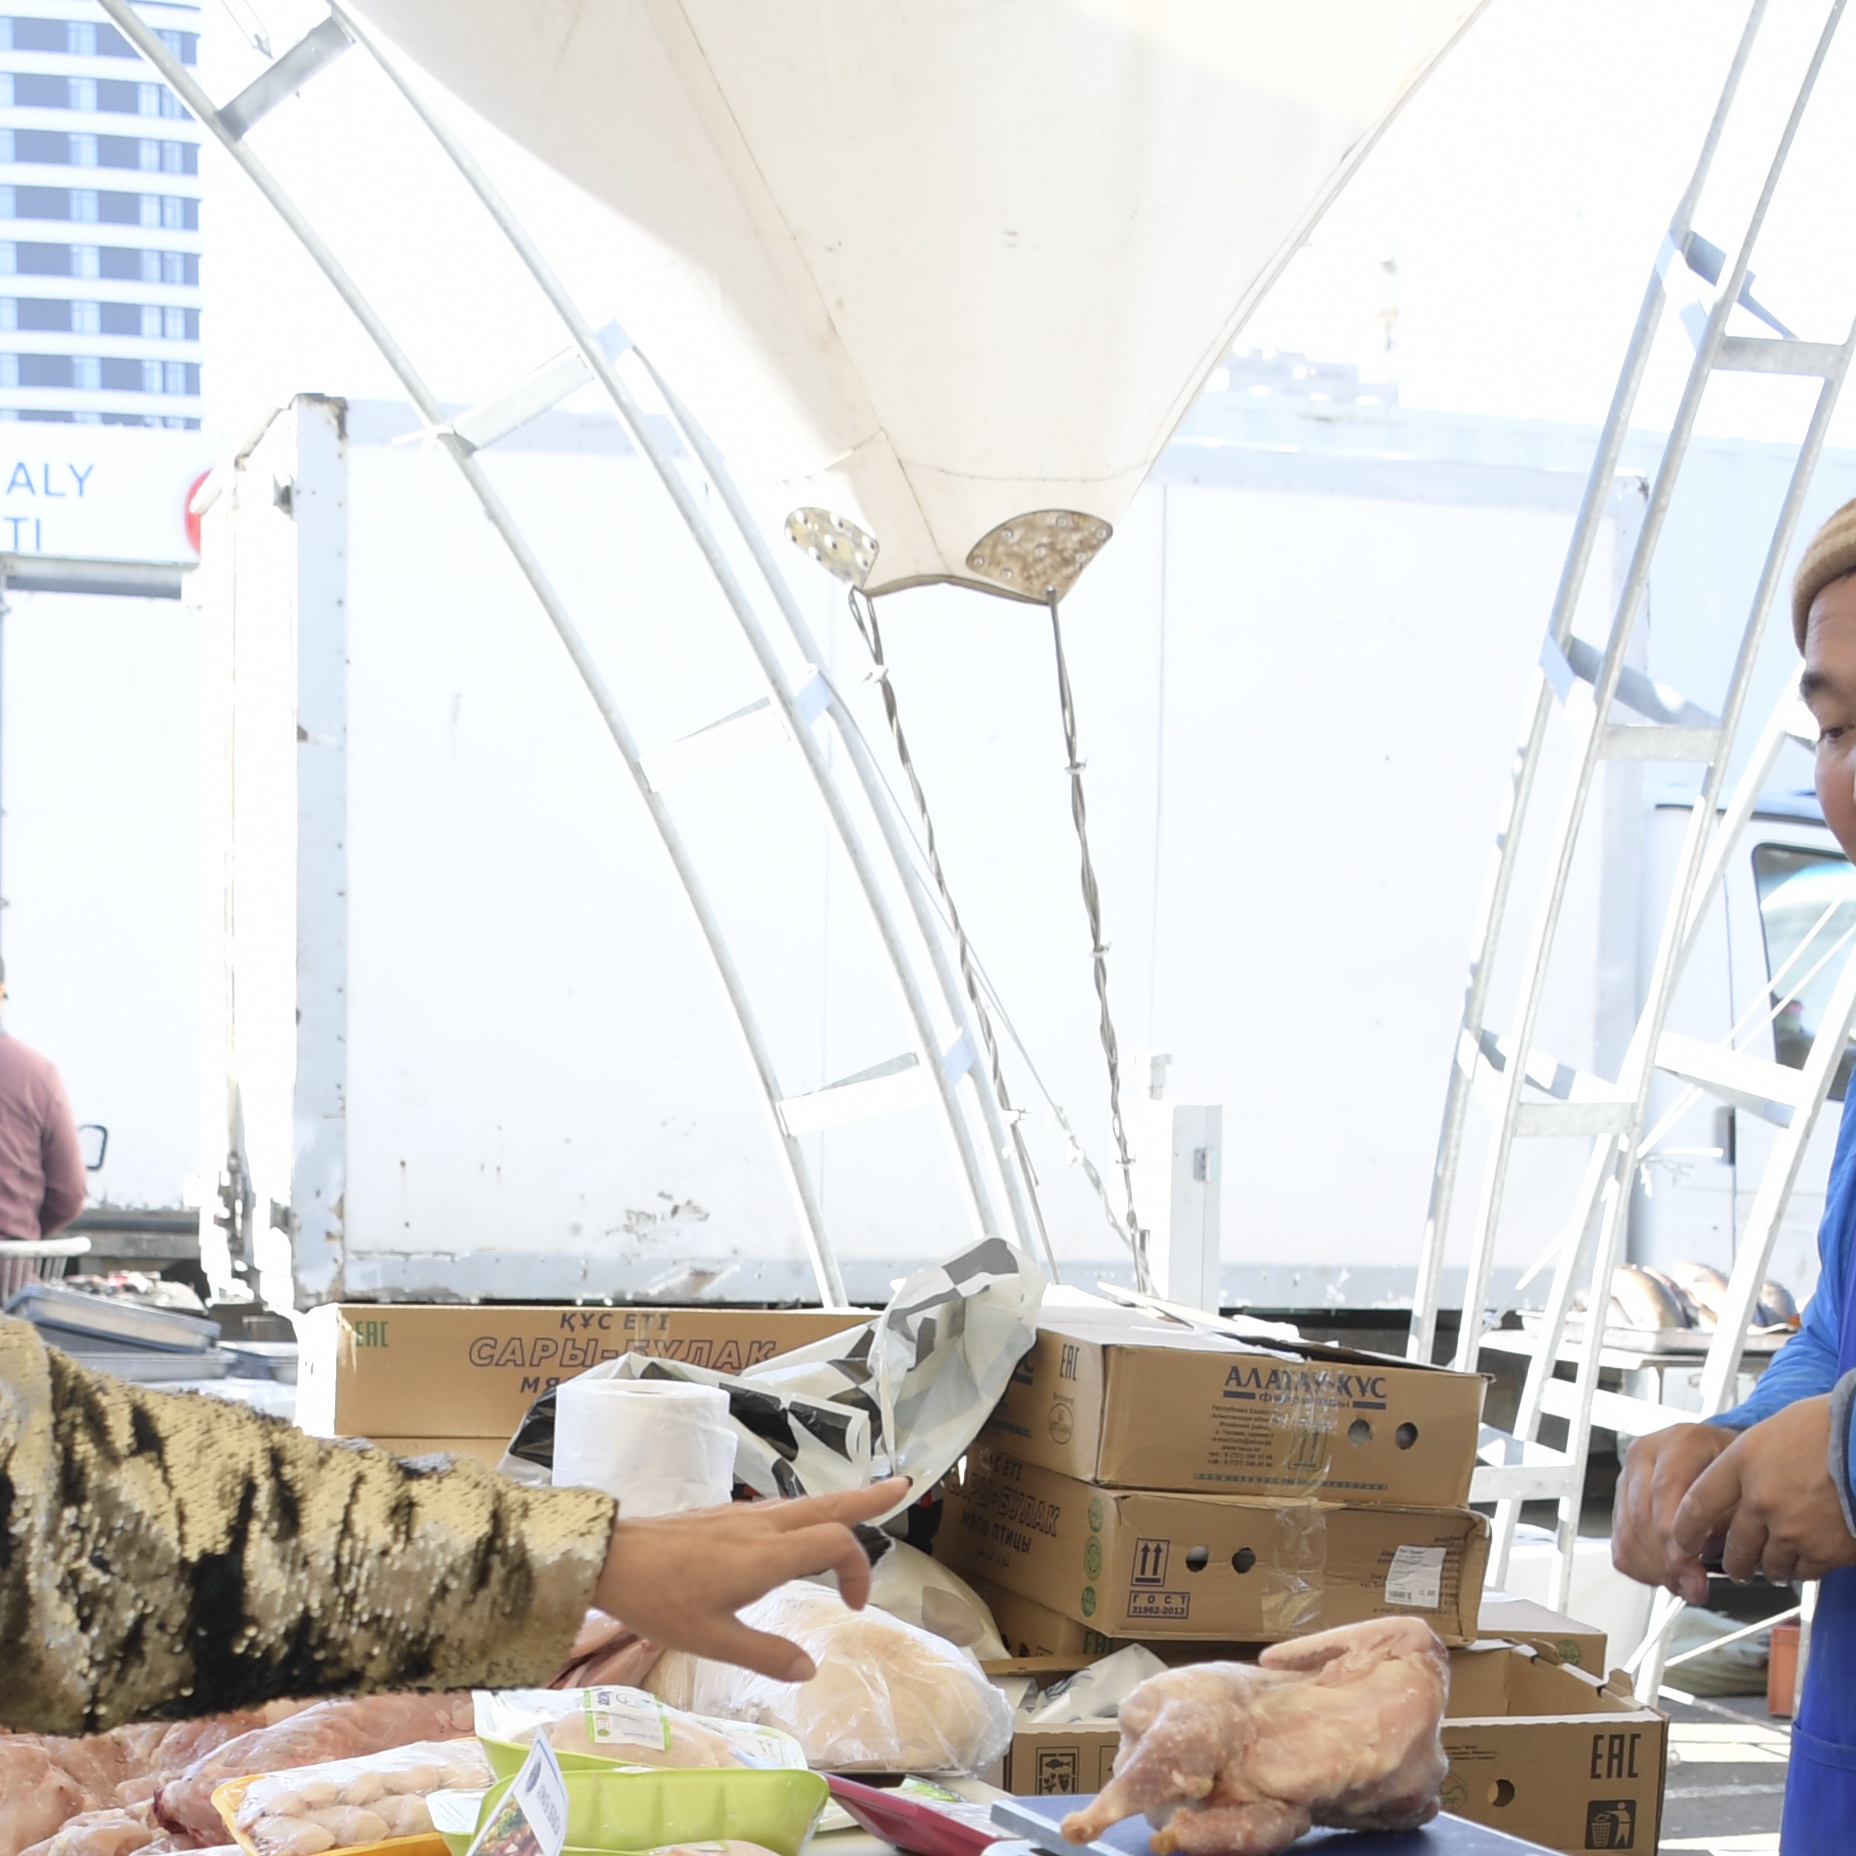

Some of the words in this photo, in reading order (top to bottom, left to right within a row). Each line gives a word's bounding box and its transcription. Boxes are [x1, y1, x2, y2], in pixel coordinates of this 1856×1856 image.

[6, 461, 94, 498] ALY
[520, 1375, 561, 1394] МЯ
[991, 1520, 1033, 1555] ПТИЦЫ
[1590, 1733, 1642, 1780] EAC
